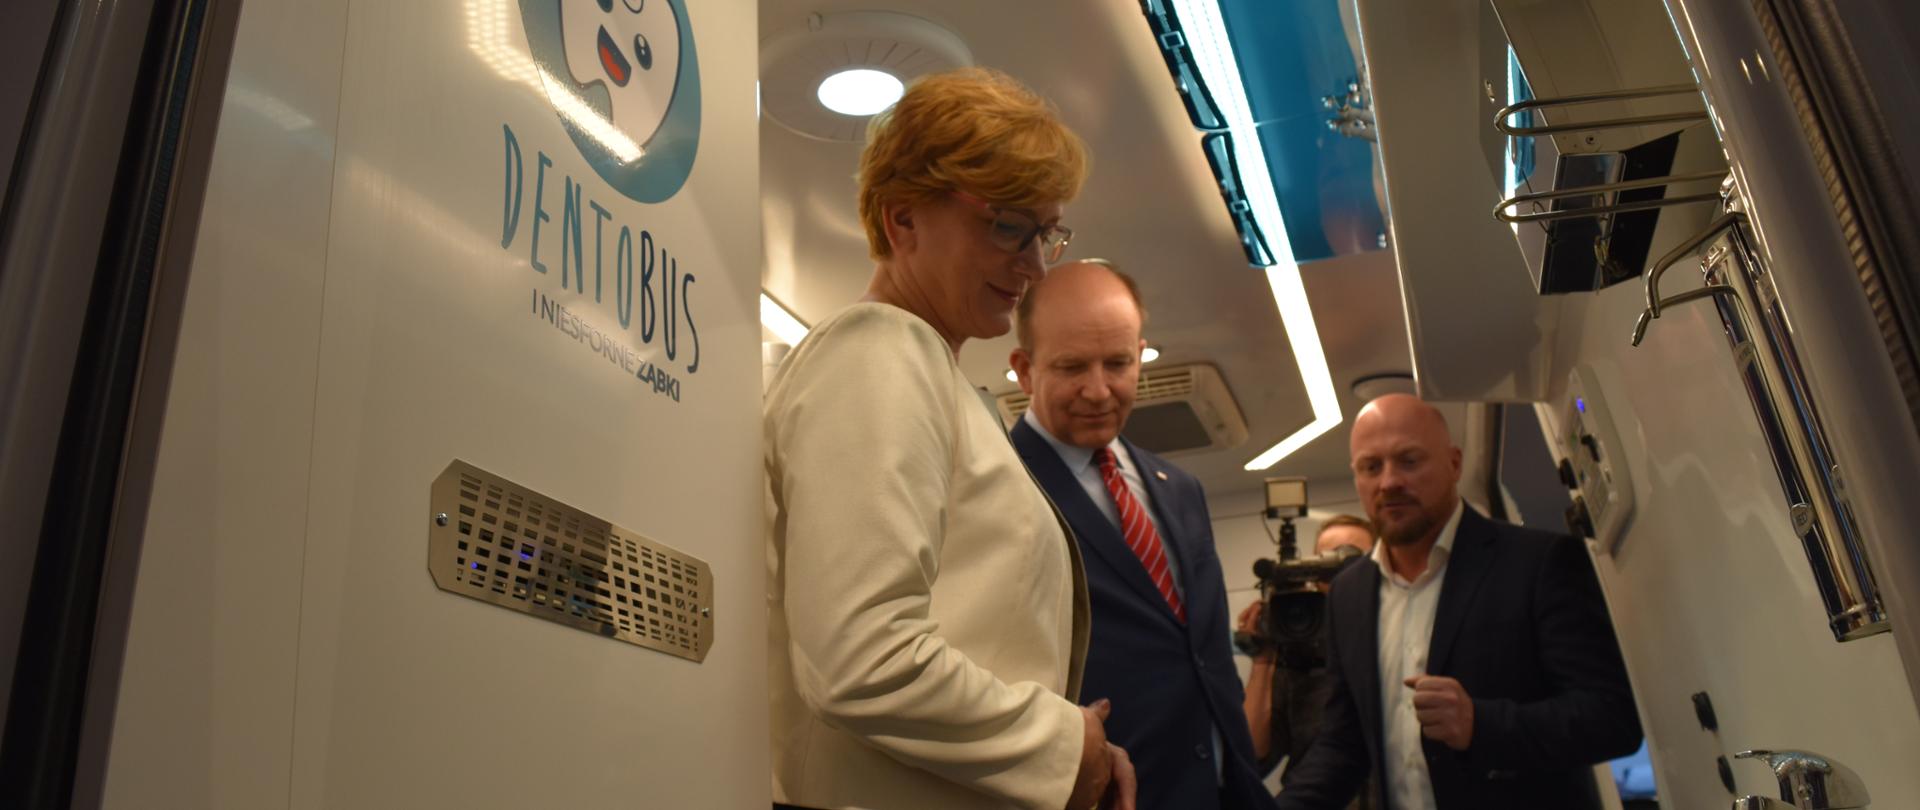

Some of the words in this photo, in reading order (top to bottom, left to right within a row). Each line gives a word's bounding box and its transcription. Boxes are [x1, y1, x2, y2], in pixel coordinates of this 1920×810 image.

[501, 123, 701, 375] DENTOBUS
[532, 288, 537, 314] I
[541, 293, 635, 376] NIESFORNE
[636, 356, 681, 403] ZĄBKI
